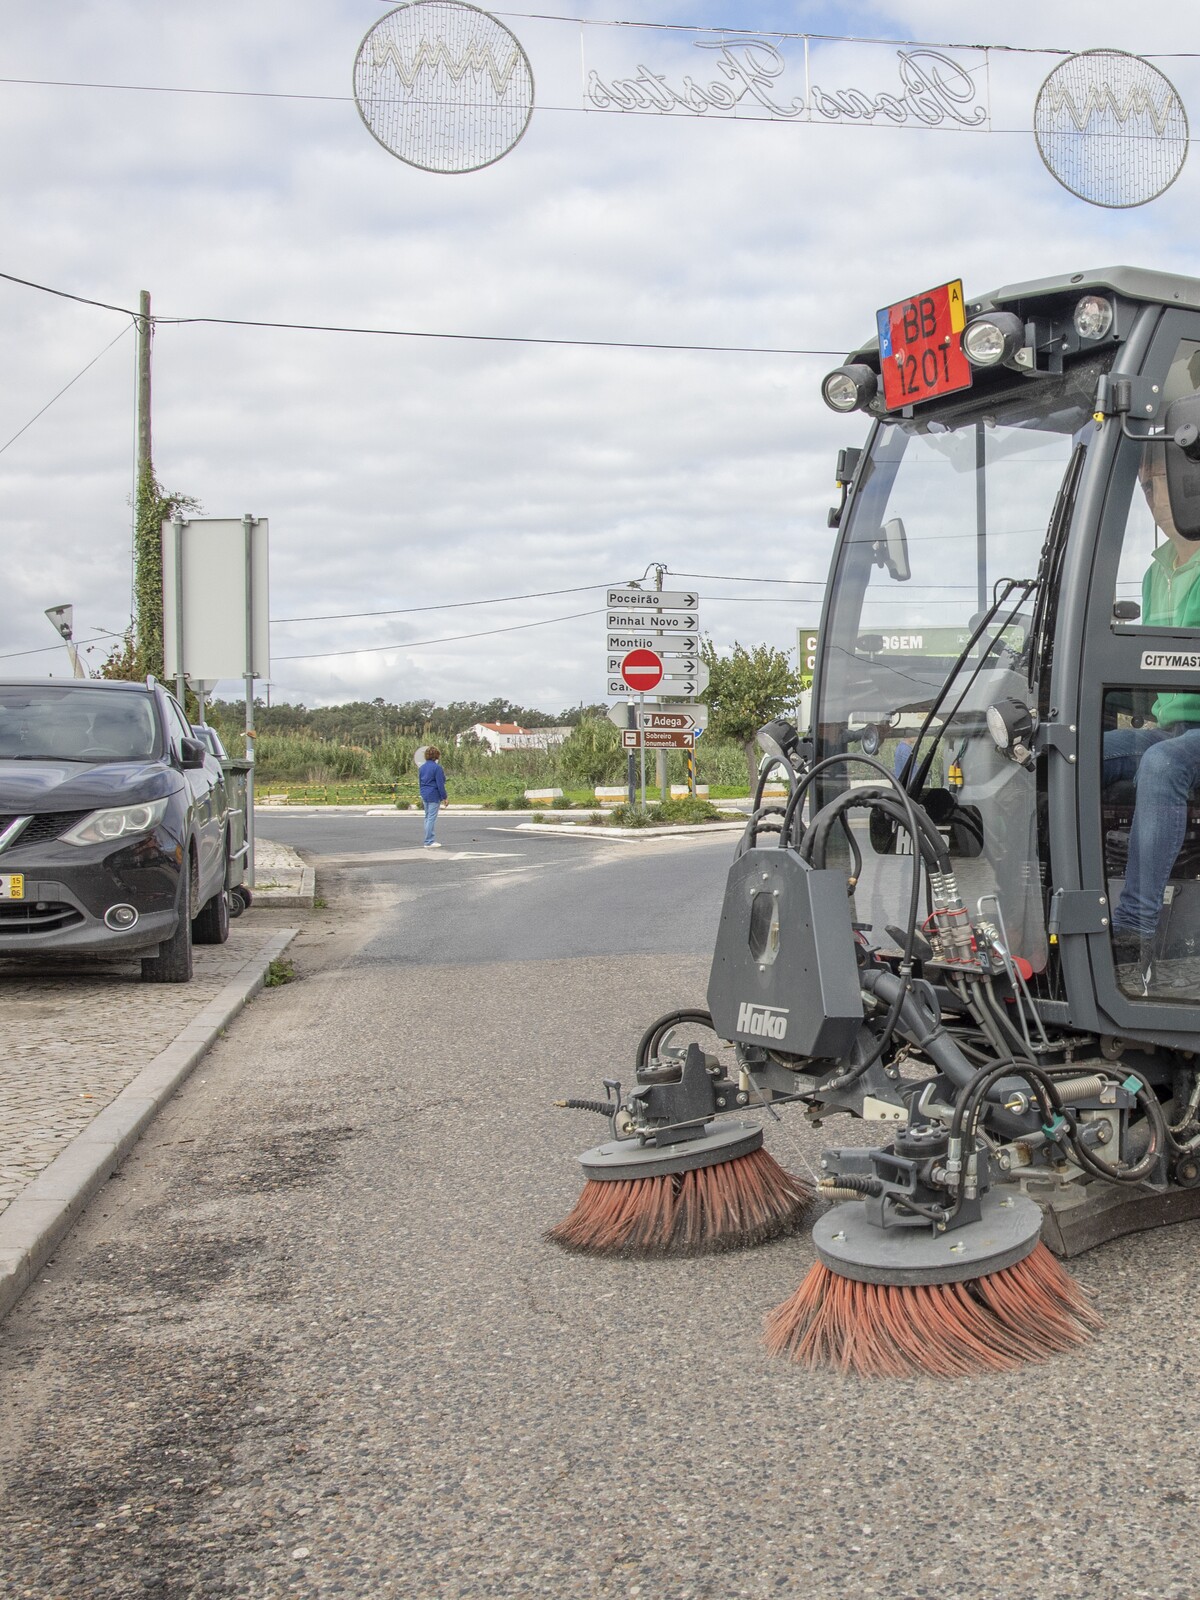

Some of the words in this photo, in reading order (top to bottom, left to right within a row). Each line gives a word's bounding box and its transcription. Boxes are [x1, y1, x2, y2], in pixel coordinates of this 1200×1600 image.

[951, 288, 959, 302] A
[902, 297, 937, 345] BB
[883, 339, 889, 350] P
[609, 593, 660, 604] Poceirão
[609, 616, 645, 626] Pinhal
[650, 617, 679, 626] Novo
[610, 638, 653, 648] Montijo
[653, 716, 682, 727] Adega
[645, 732, 672, 740] Sobreiro
[736, 1001, 790, 1040] Hako
